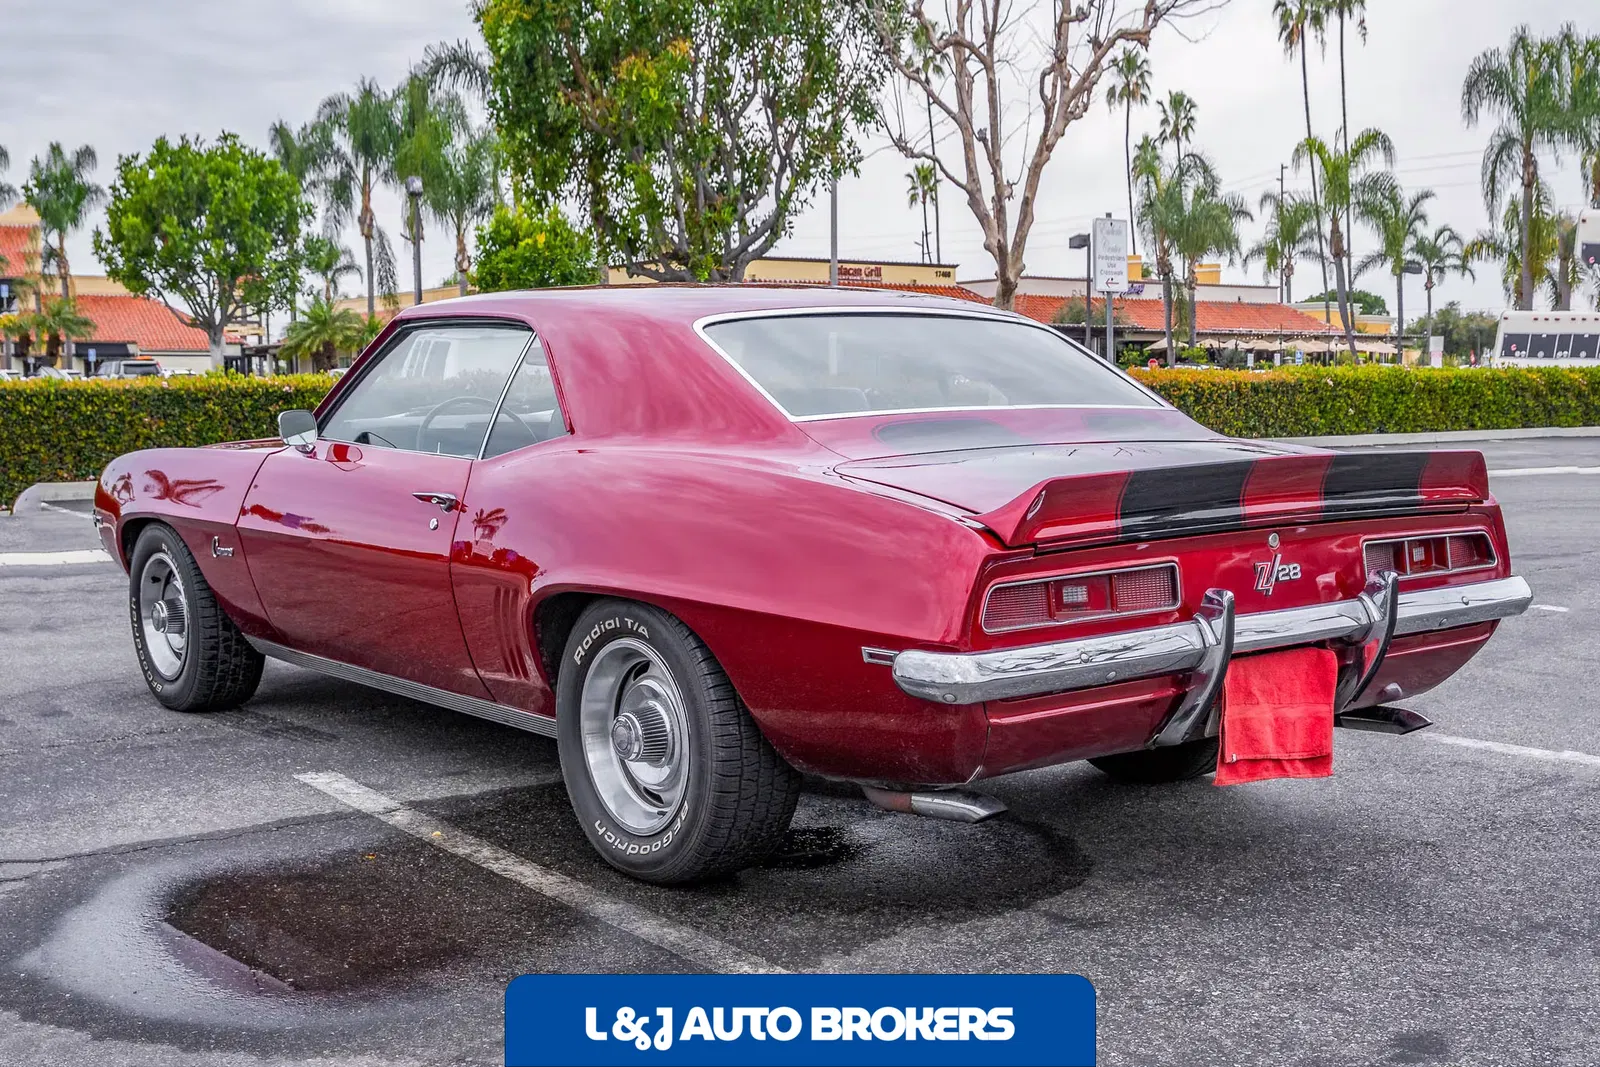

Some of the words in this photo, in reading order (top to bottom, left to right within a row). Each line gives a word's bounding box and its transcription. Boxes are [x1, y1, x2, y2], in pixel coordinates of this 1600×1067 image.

[864, 266, 882, 277] Grill
[573, 617, 621, 666] Radial
[624, 617, 650, 640] T/A
[594, 800, 689, 856] BFGoodrich
